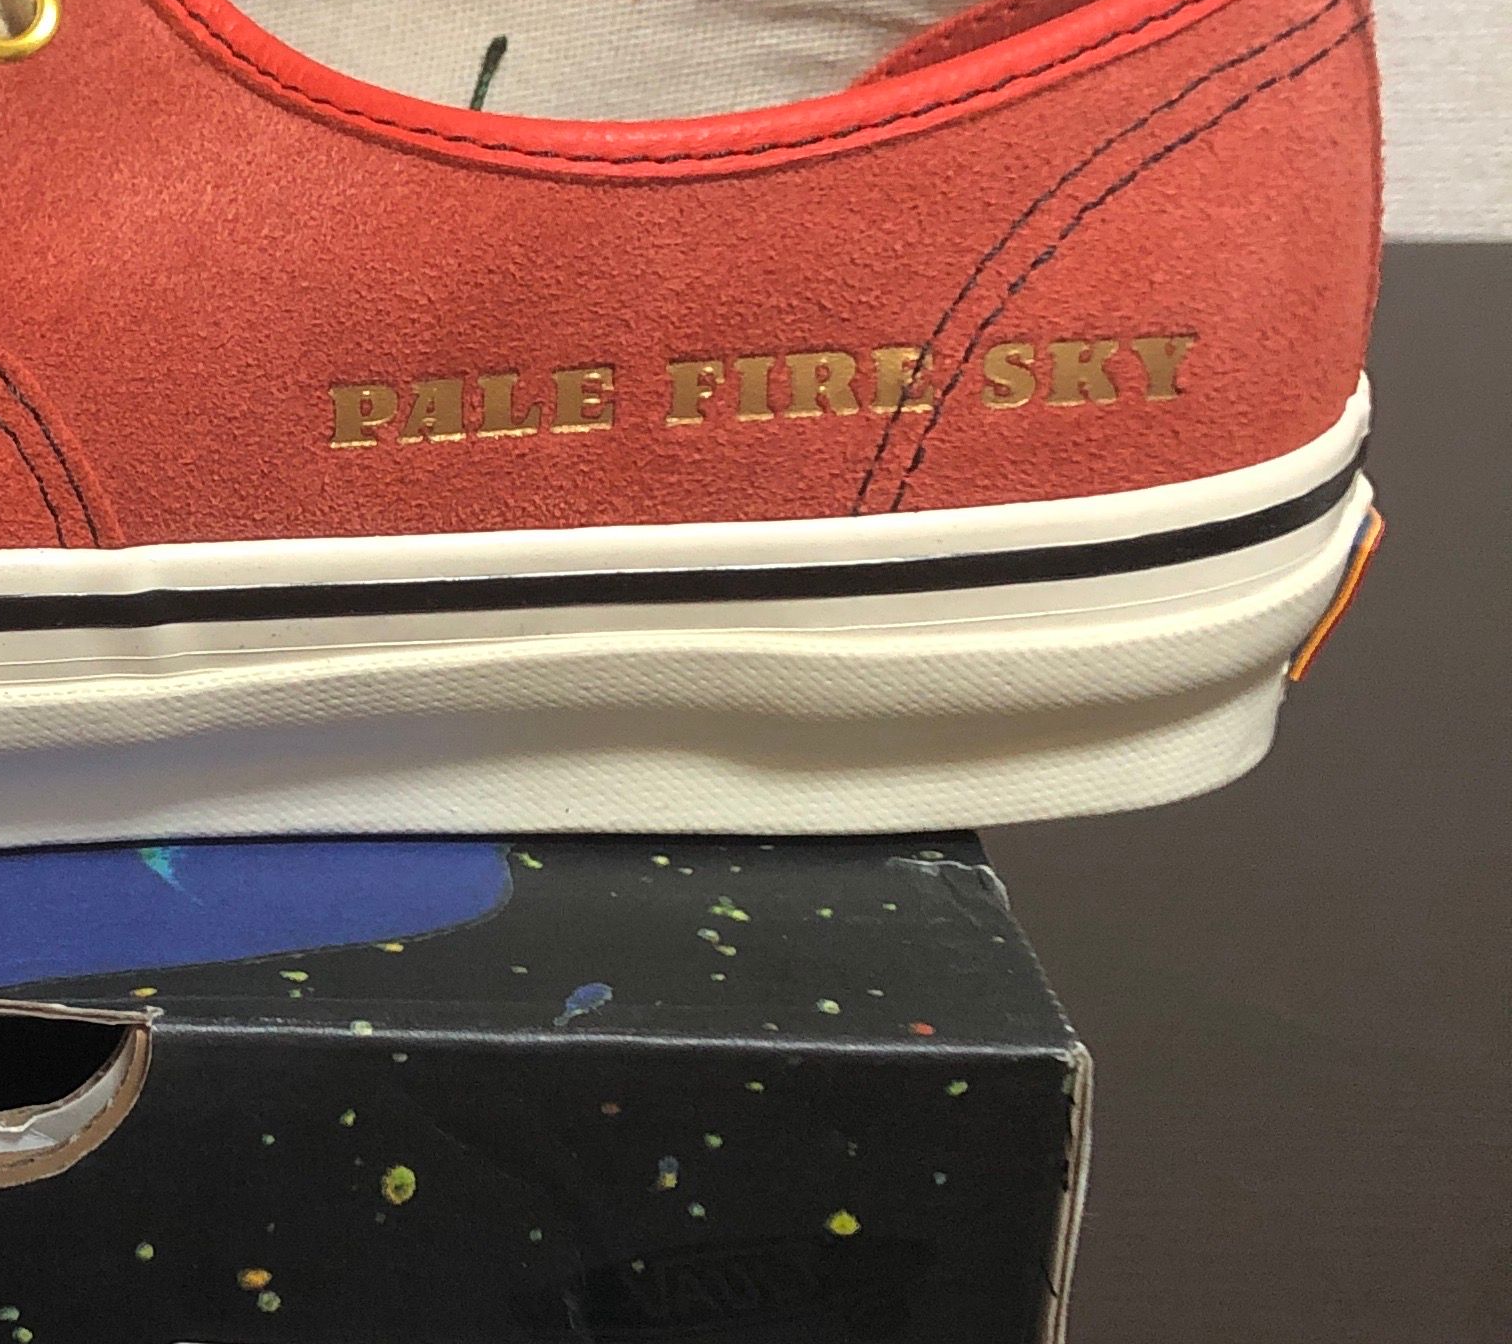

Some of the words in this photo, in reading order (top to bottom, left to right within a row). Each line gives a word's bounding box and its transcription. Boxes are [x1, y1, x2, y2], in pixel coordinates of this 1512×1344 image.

[327, 368, 615, 448] PALE
[664, 344, 937, 425] FIRE
[978, 331, 1199, 410] SKY
